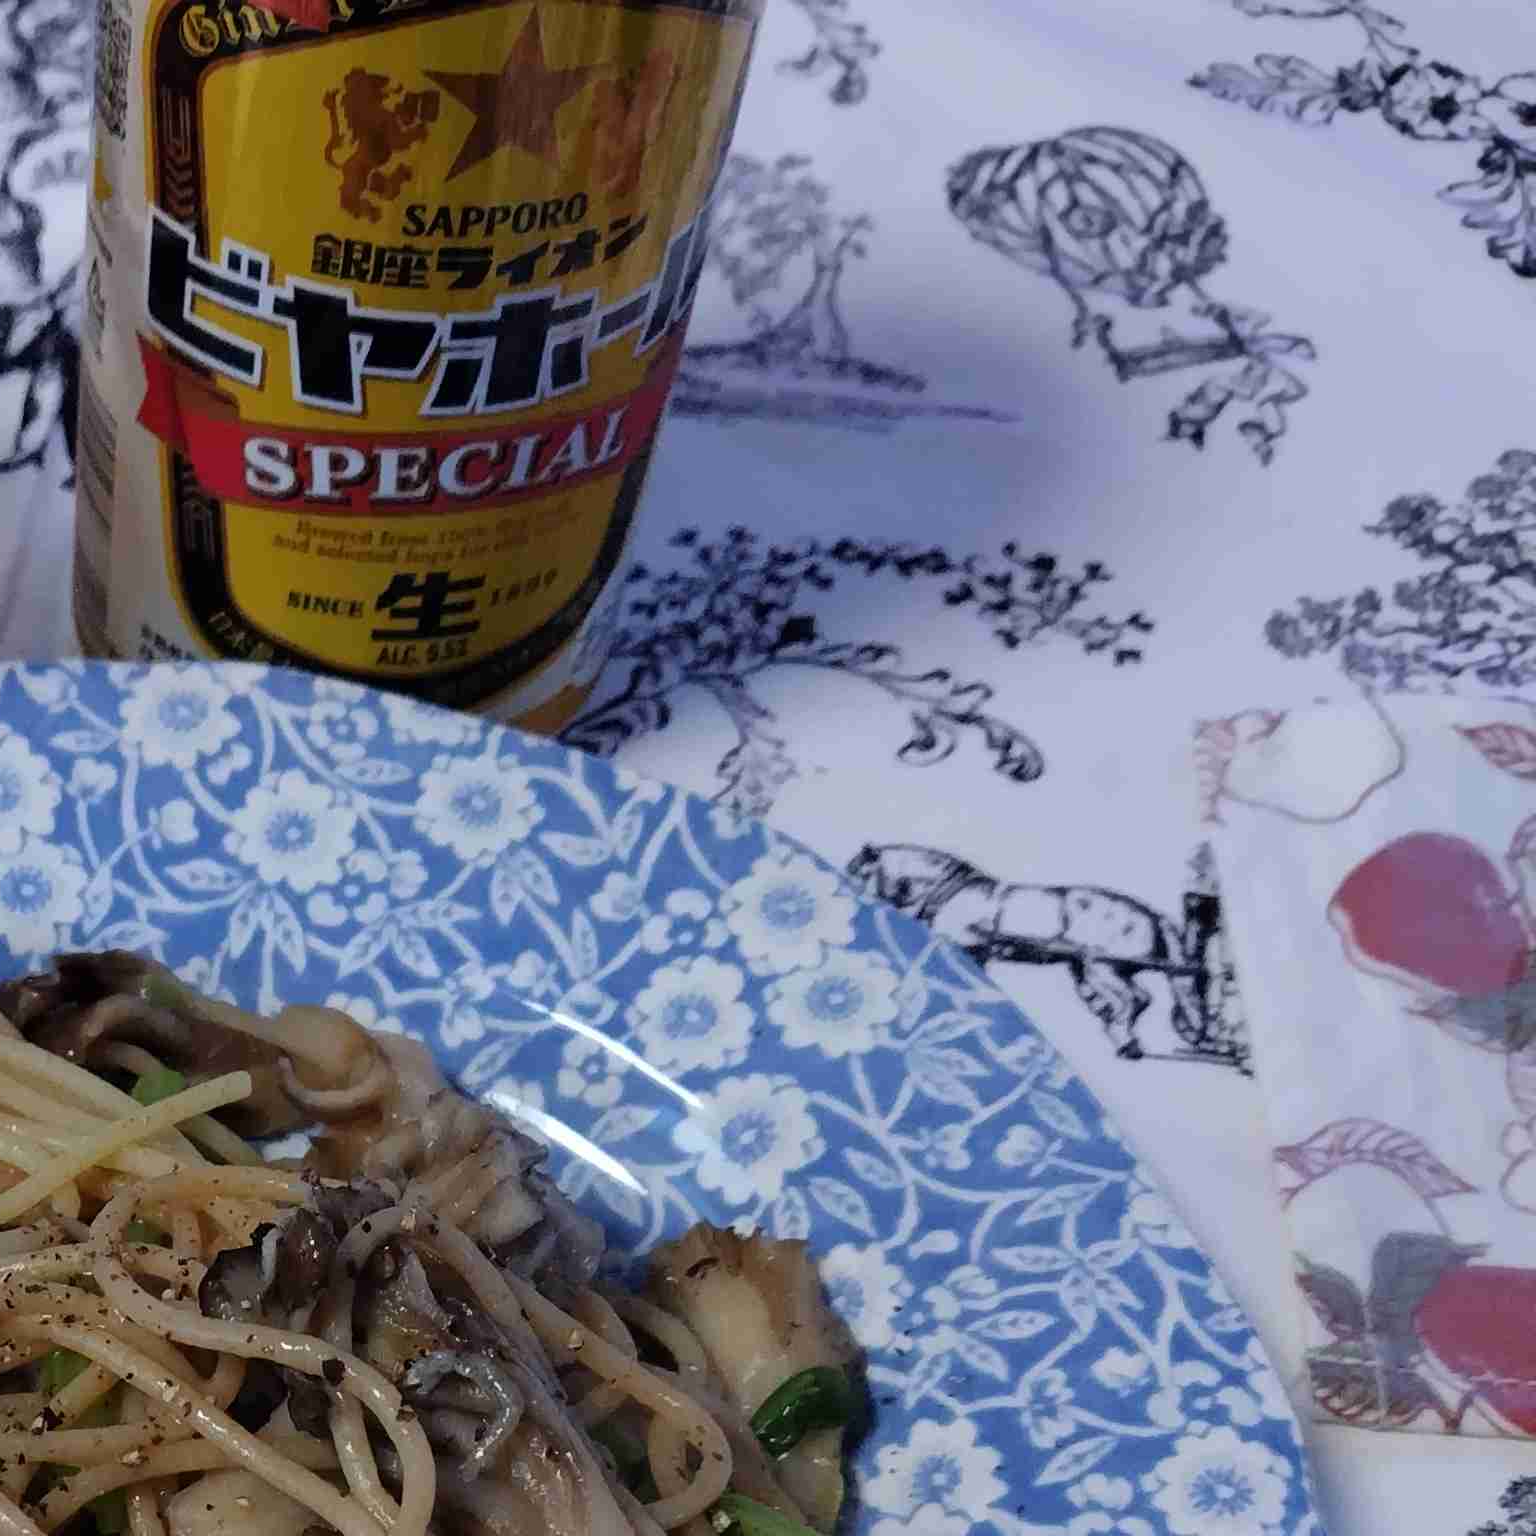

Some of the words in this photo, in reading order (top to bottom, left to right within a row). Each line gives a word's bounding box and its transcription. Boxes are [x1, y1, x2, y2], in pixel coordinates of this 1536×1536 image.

[401, 192, 589, 238] SAPPORO
[311, 213, 650, 290] 銀座ライオン
[242, 407, 628, 502] SPECIAL
[286, 591, 365, 619] SINCE
[370, 571, 487, 641] 生
